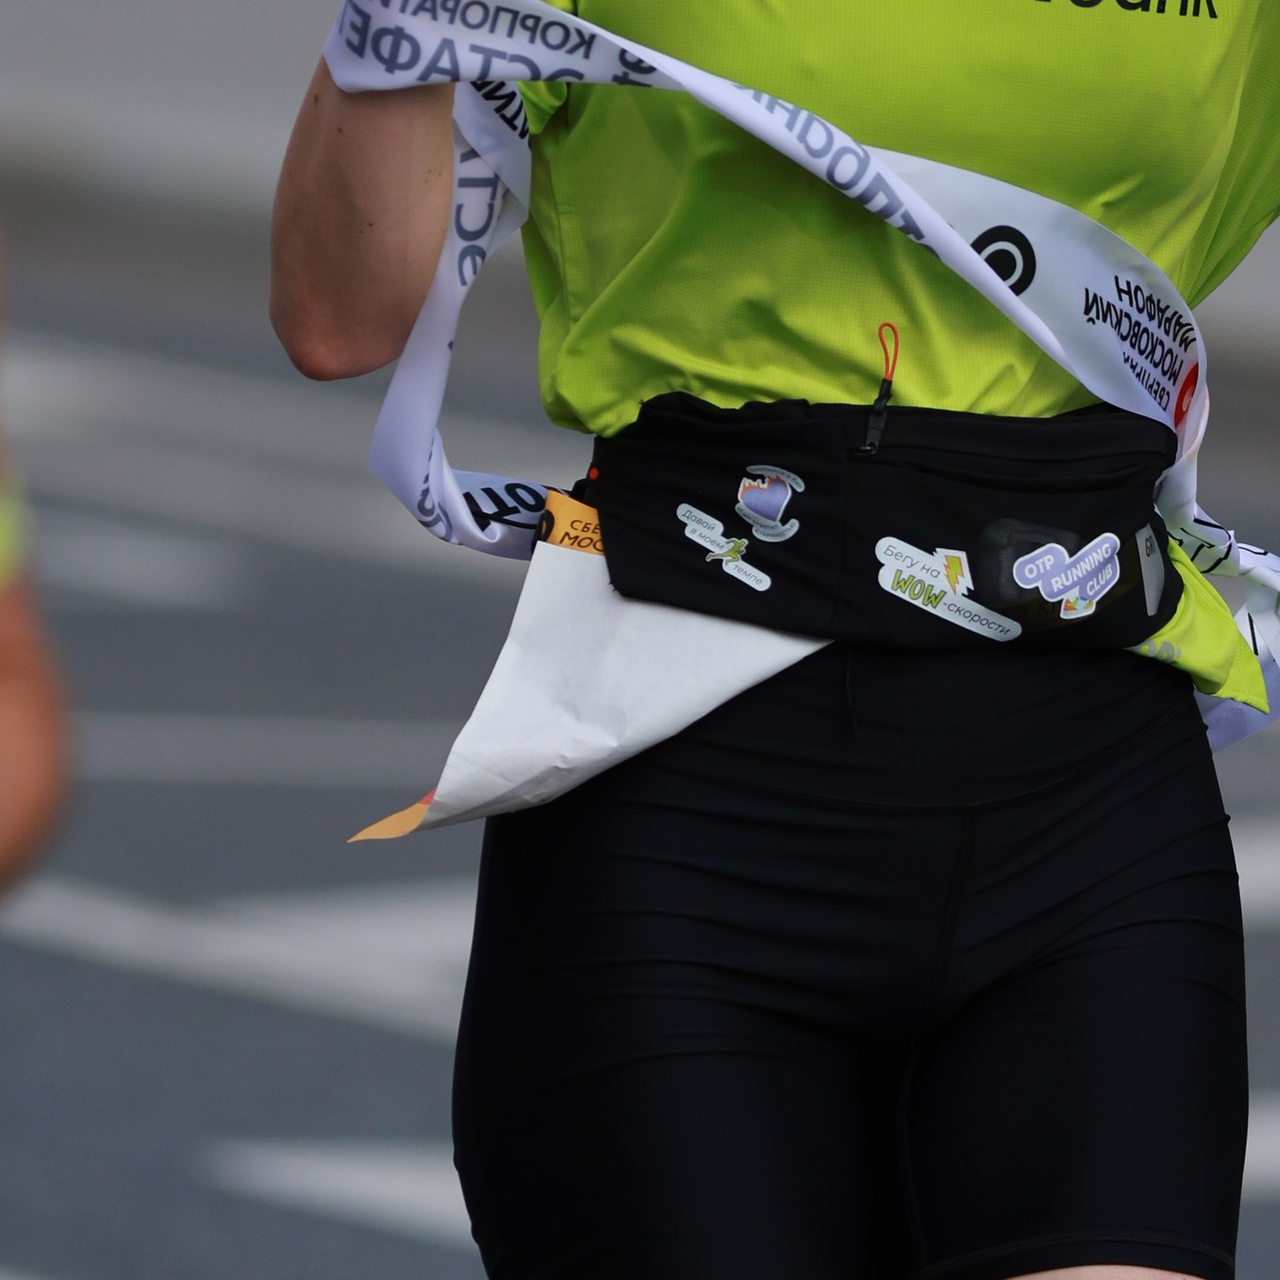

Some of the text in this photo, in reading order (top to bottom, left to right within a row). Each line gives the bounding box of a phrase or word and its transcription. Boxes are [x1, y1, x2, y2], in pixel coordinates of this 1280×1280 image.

[1114, 275, 1197, 353] МАРАФОН
[1083, 288, 1183, 386] МОСКОВСКИЙ
[682, 509, 716, 531] Давай
[733, 564, 763, 585] темпе
[883, 544, 941, 579] Бегу на
[1024, 554, 1054, 579] OTP
[1051, 543, 1112, 593] RUNNING
[1086, 563, 1113, 596] CLUB
